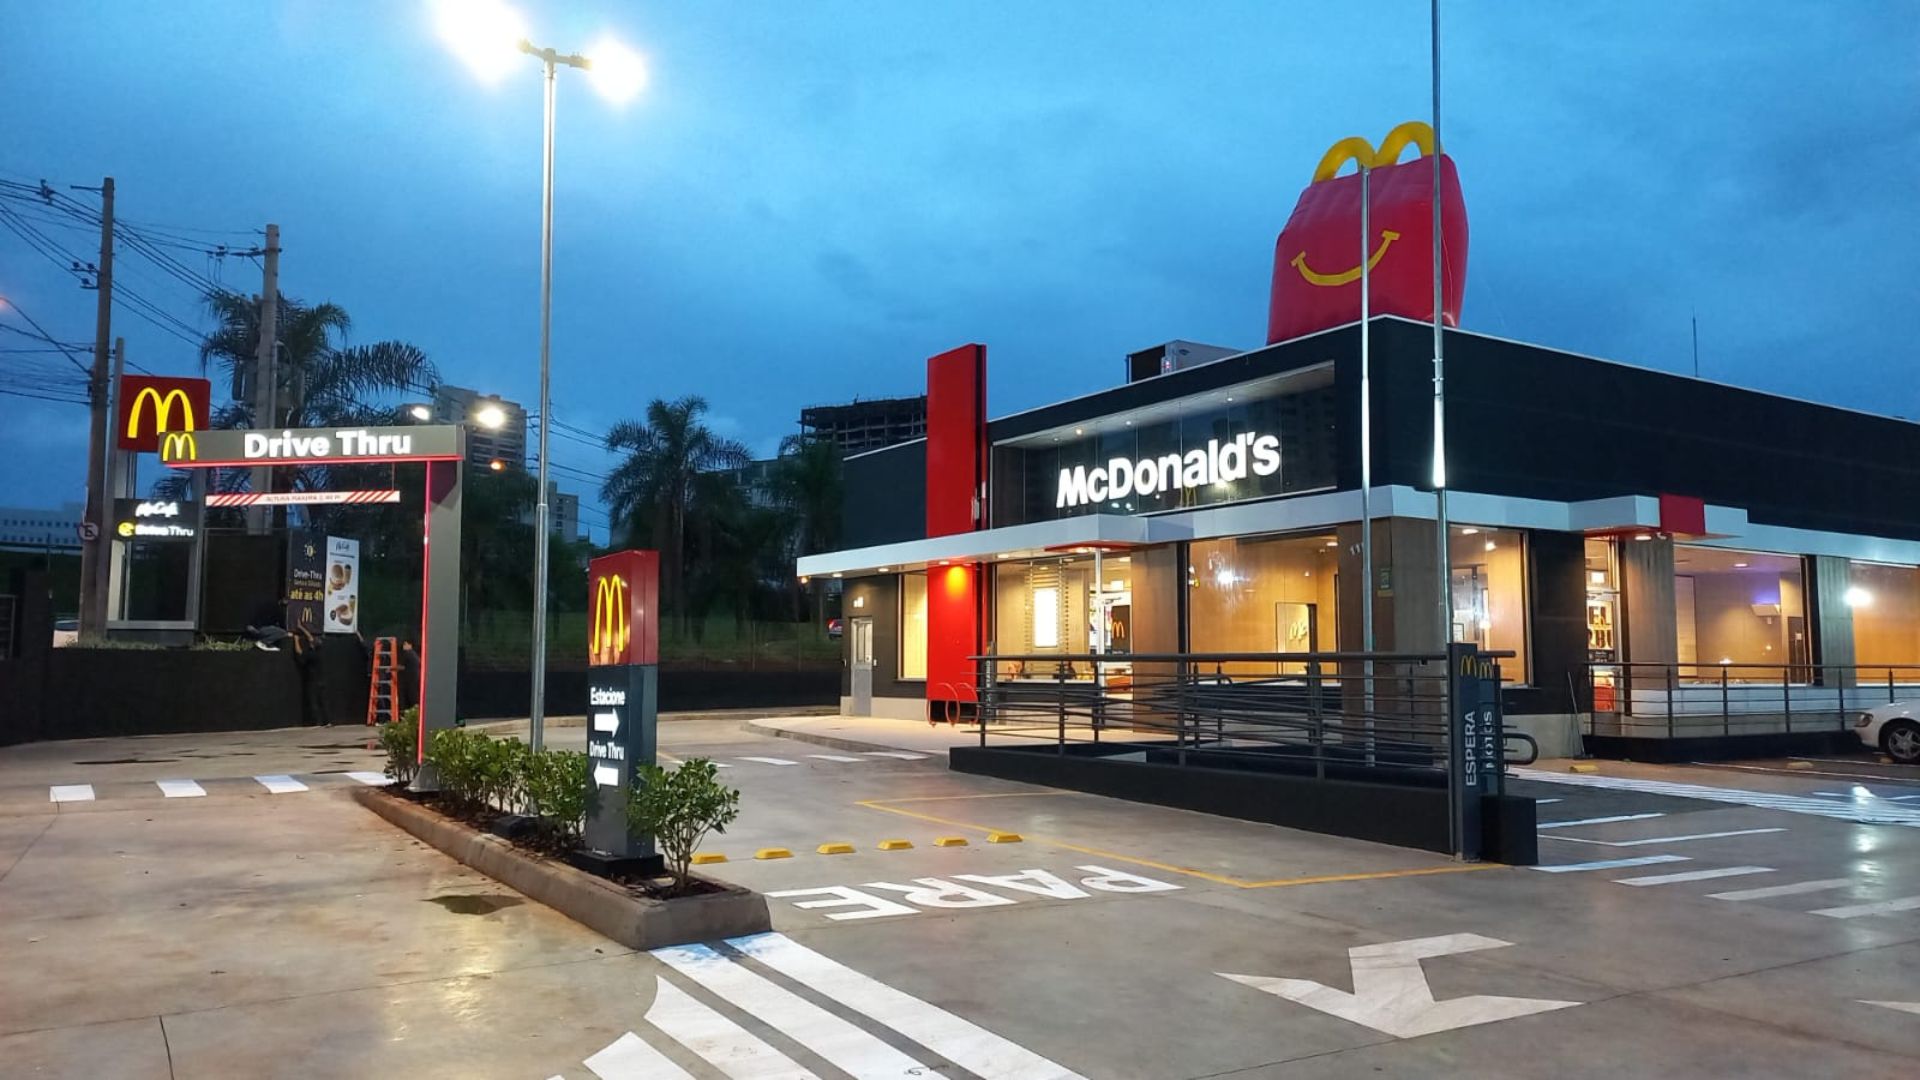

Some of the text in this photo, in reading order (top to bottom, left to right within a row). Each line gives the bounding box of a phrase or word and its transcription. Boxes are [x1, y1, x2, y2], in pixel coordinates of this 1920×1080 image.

[244, 429, 412, 458] Drive Thru
[1056, 431, 1280, 509] McDonald's
[590, 686, 626, 706] Estacione
[589, 740, 625, 761] Drive Thru
[1464, 711, 1477, 787] ESPERA
[763, 865, 1187, 921] PARE
